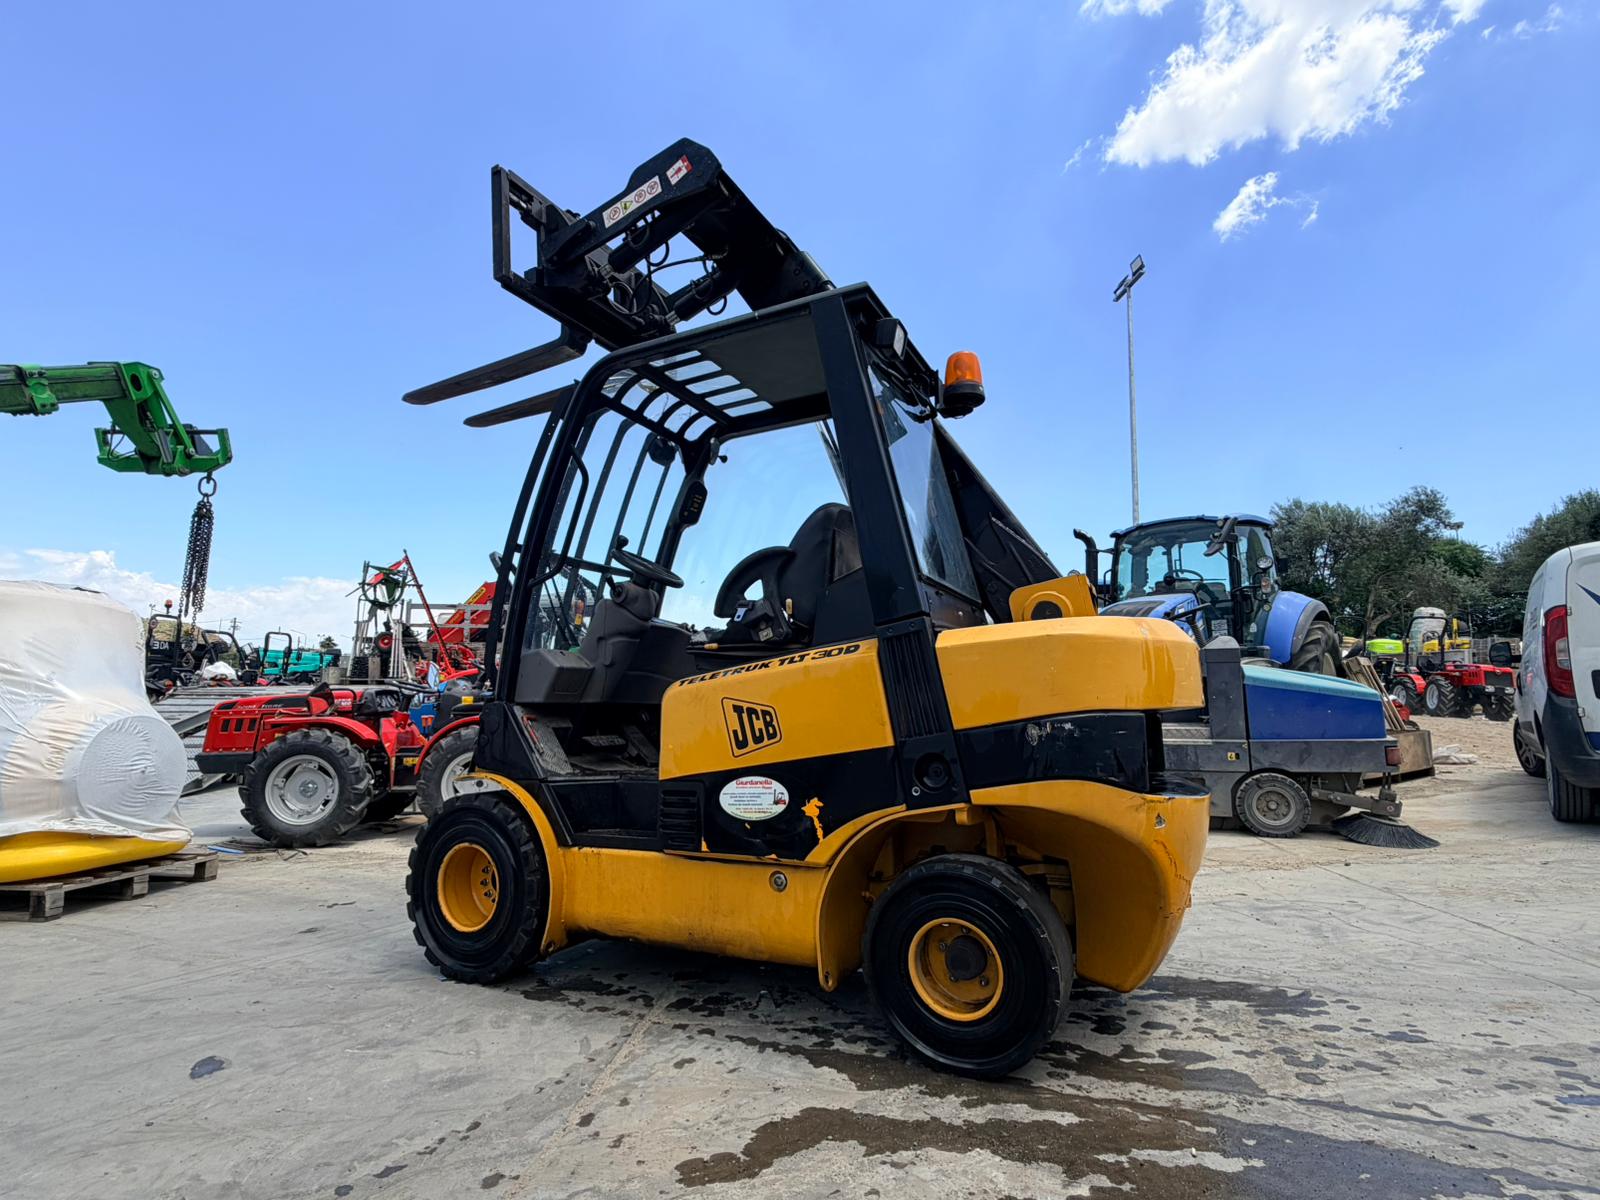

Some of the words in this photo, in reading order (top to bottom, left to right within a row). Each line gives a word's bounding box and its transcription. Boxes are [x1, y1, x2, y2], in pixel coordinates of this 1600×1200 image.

[678, 661, 772, 687] TELETRUK
[776, 653, 810, 667] TLT
[811, 644, 861, 660] 30D
[731, 703, 778, 751] JCB
